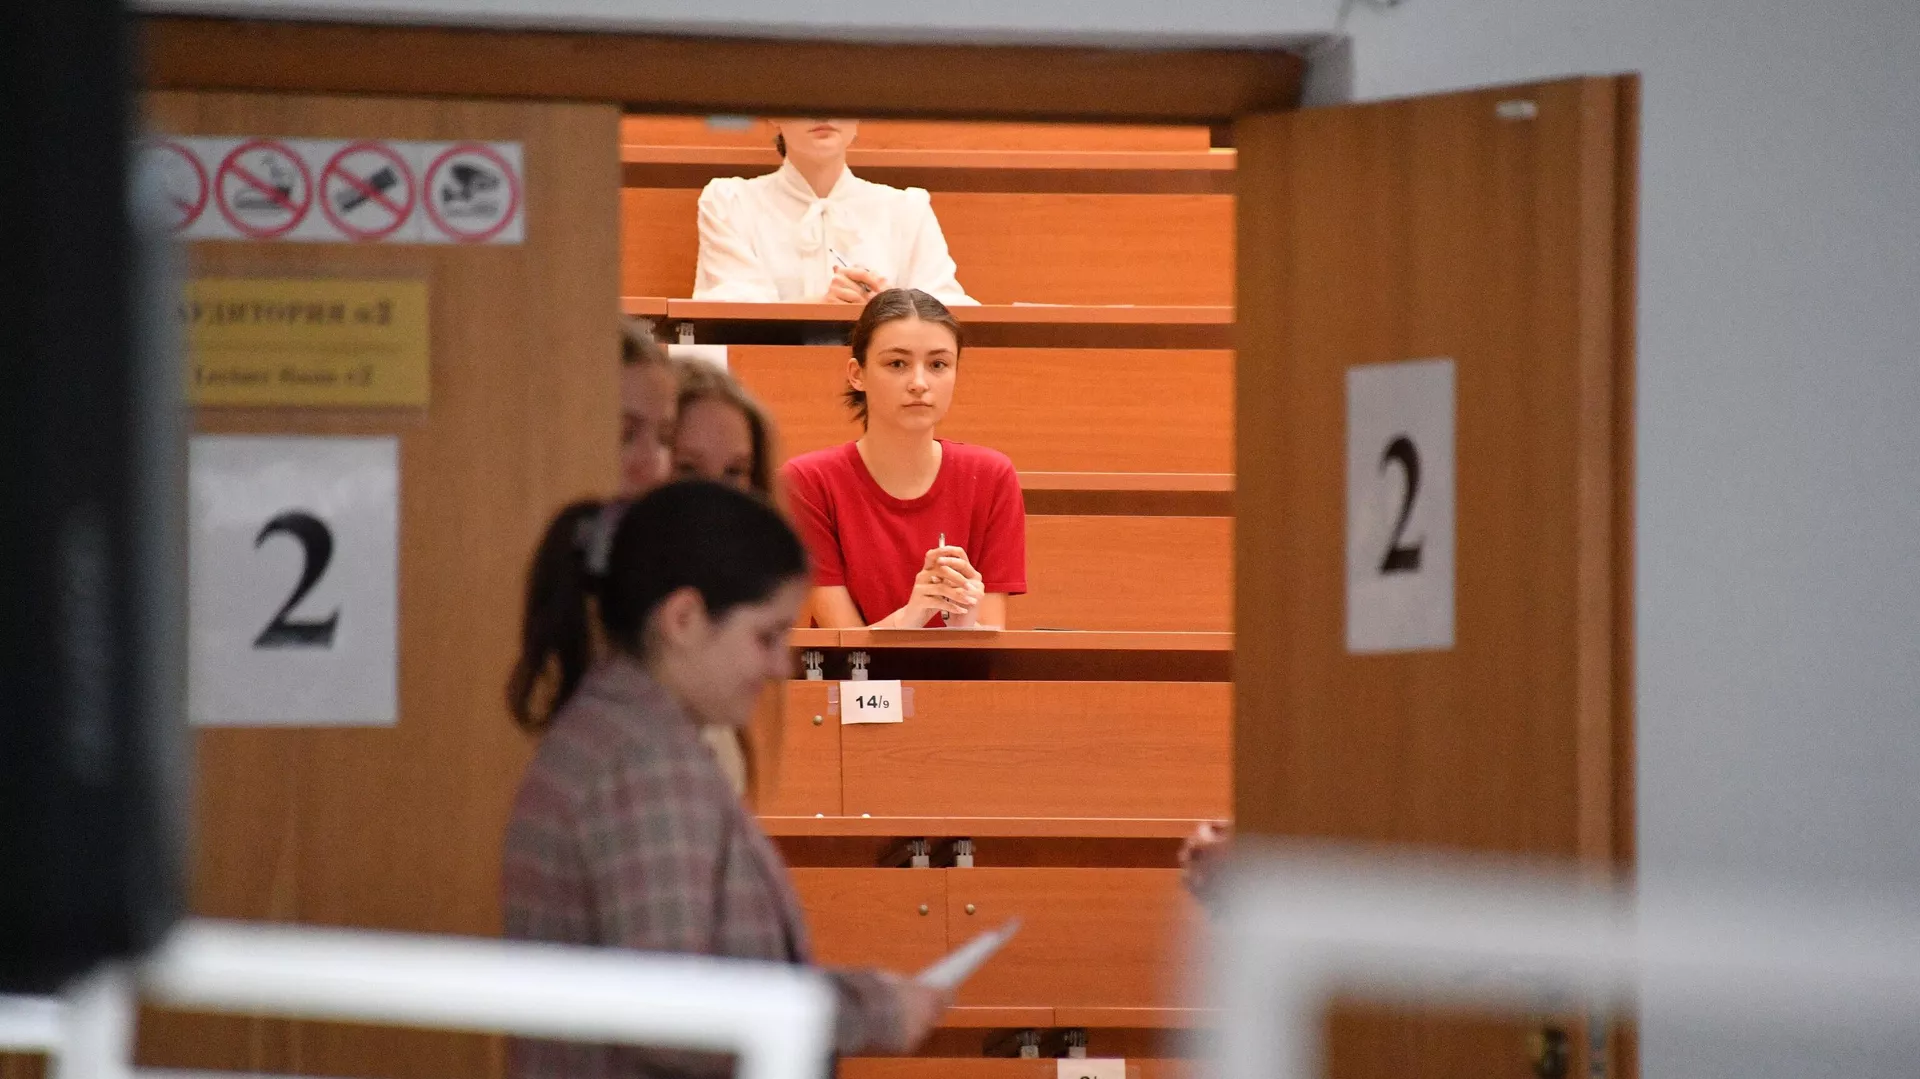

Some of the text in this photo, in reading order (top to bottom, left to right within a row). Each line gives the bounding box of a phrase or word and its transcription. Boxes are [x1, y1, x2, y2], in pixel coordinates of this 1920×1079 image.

[1378, 434, 1424, 574] 2
[253, 510, 340, 649] 2
[855, 695, 890, 709] 14/9
